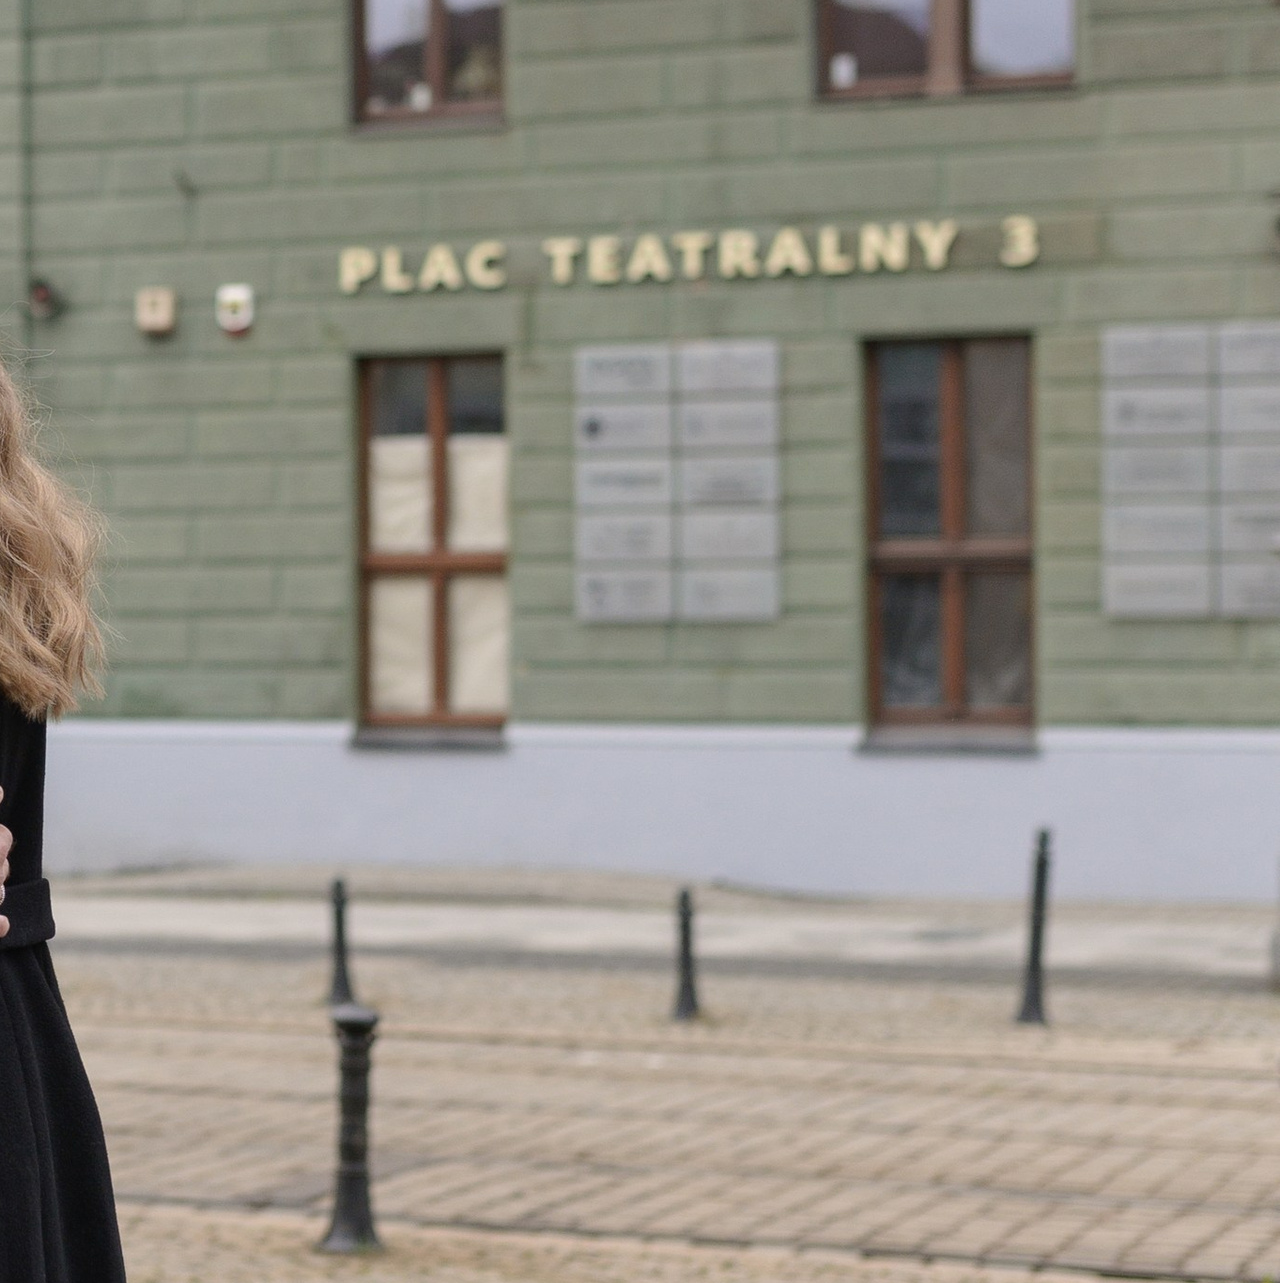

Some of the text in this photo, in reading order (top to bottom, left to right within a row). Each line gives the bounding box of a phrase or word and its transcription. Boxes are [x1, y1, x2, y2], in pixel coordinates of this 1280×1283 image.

[338, 214, 1038, 295] PLAC TEATRALNY 3
